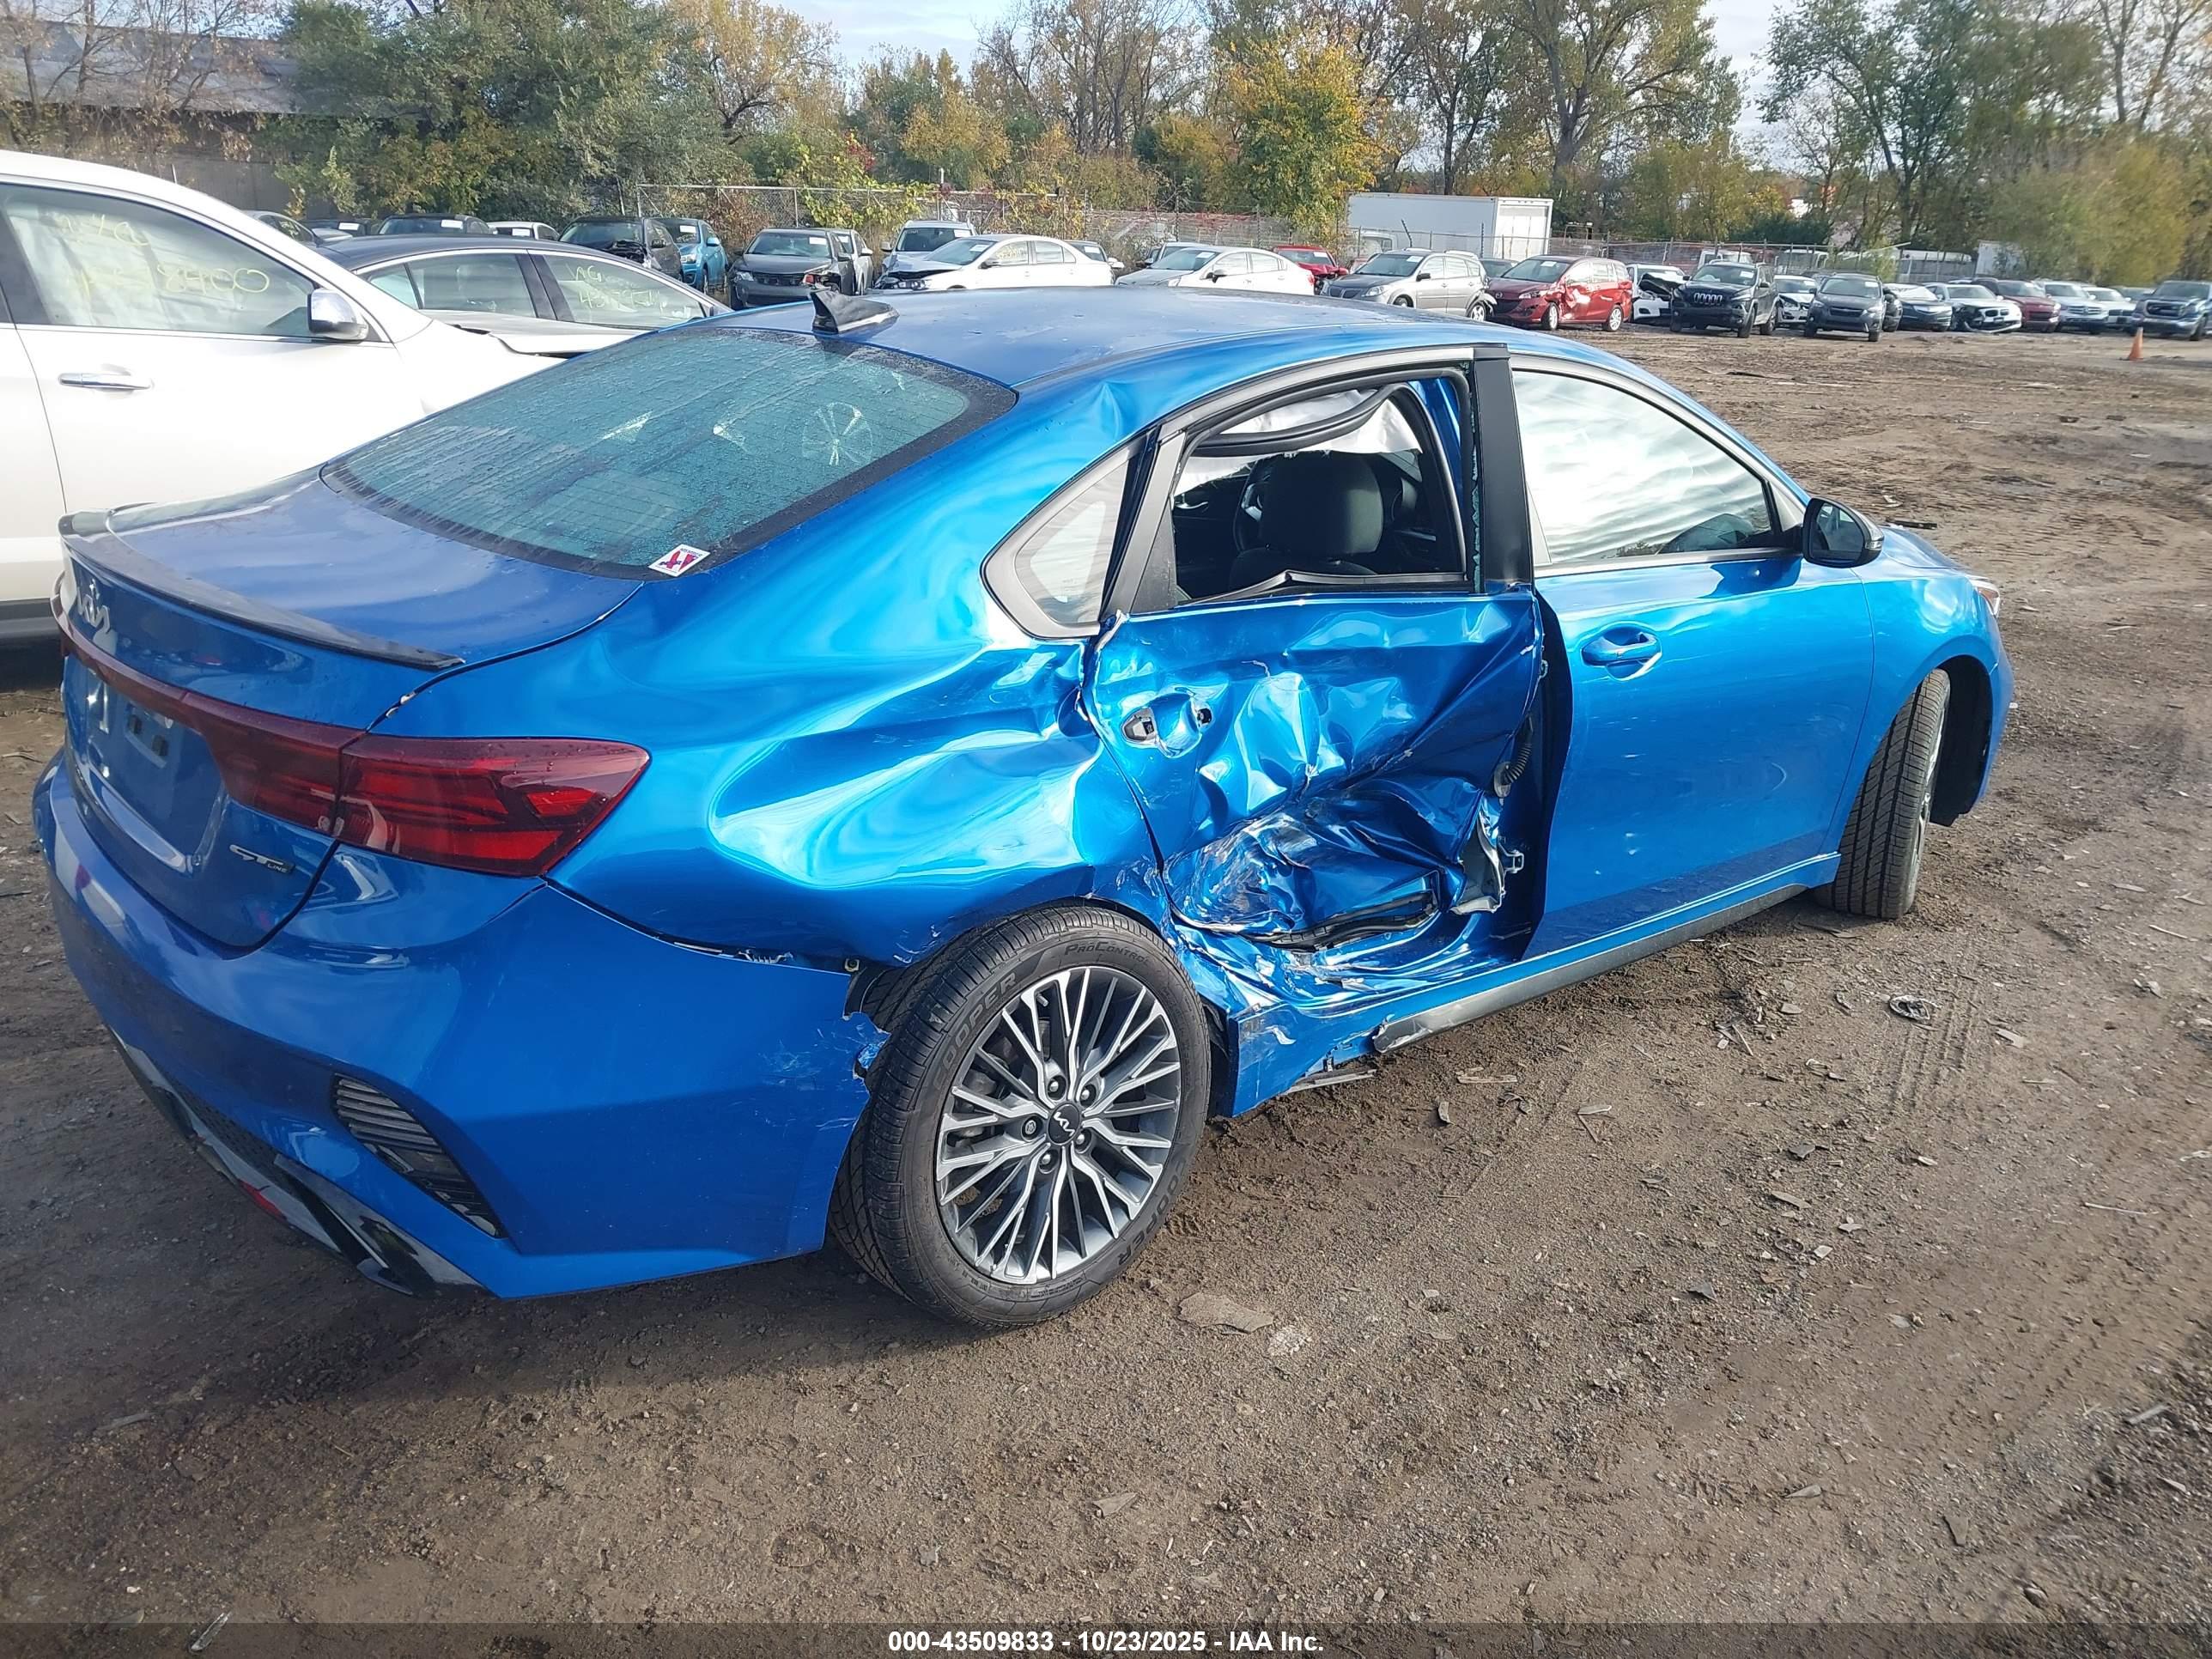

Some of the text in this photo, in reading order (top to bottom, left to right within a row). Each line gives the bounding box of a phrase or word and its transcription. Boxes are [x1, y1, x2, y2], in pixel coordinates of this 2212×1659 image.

[229, 844, 284, 864] GT
[933, 972, 1017, 1091] COOPER
[1118, 1159, 1187, 1266] COOPER
